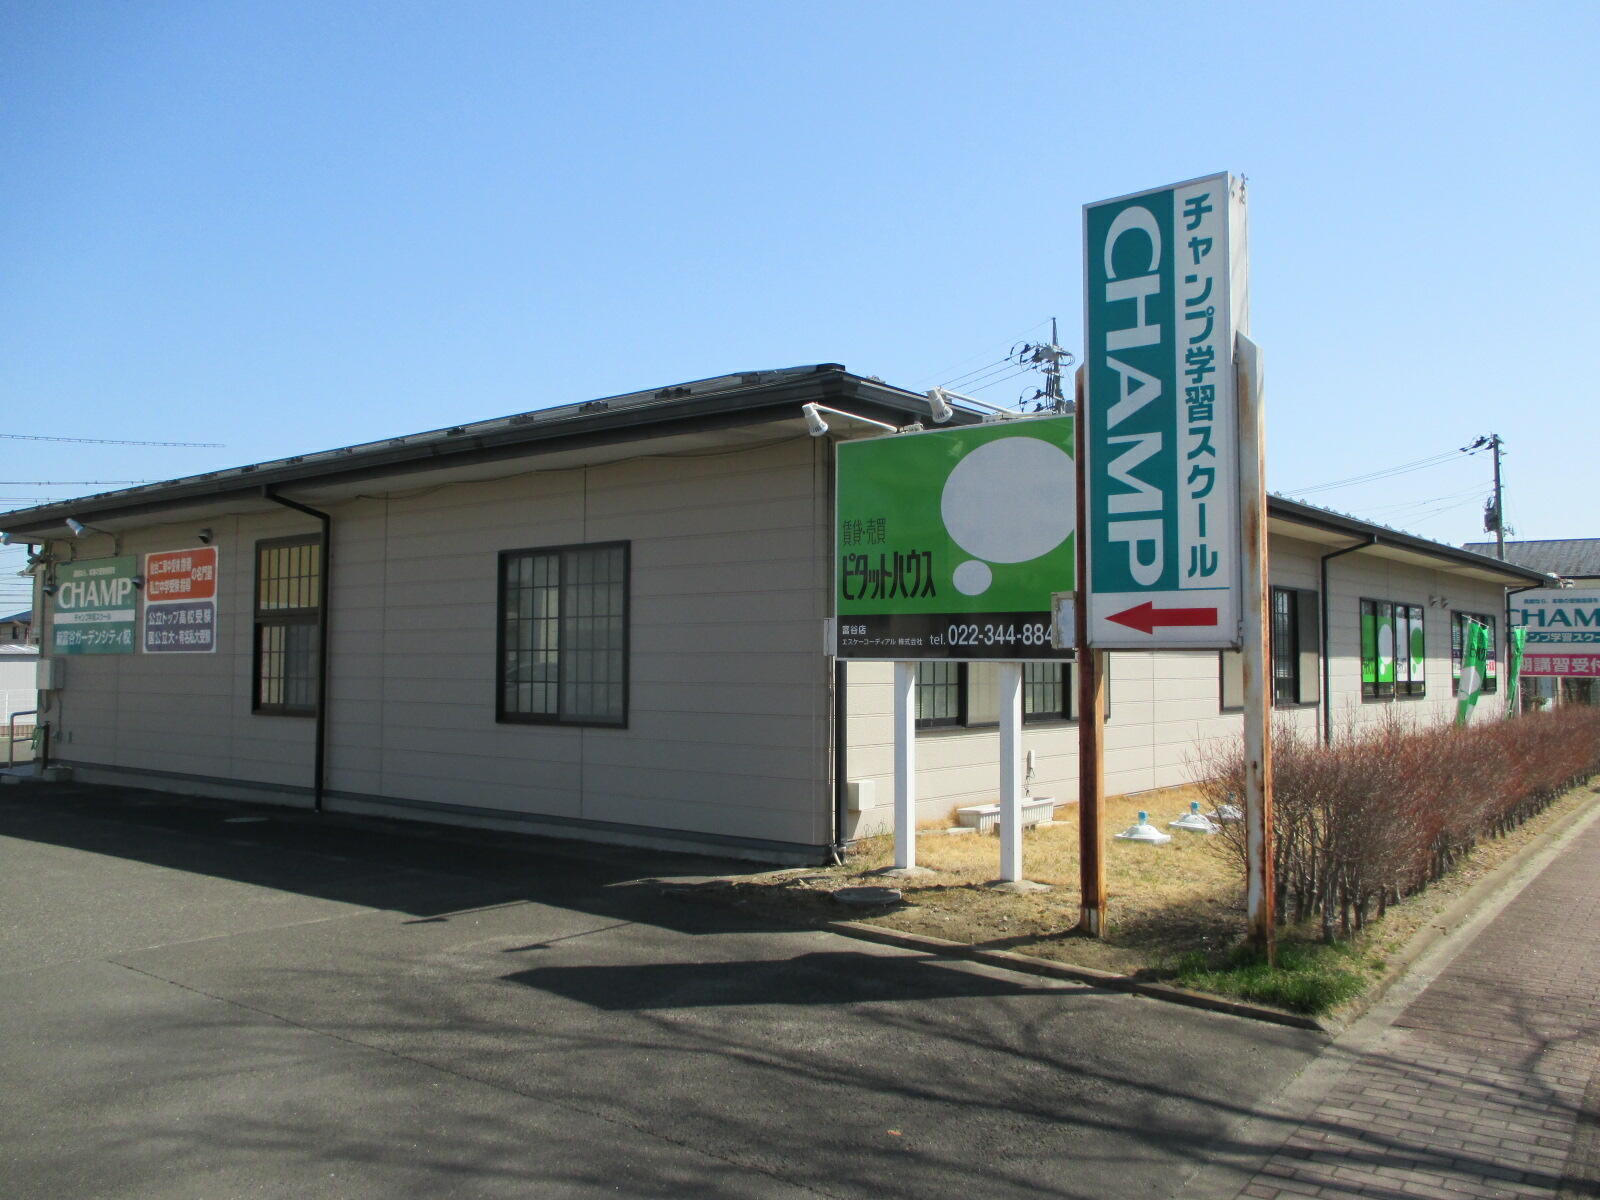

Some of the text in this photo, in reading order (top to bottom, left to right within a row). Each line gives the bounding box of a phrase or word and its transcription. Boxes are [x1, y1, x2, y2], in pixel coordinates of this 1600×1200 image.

[1103, 205, 1165, 586] CHAMP
[1182, 193, 1219, 579] チャンプ学習スクール
[842, 549, 936, 600] ピタットハウス
[58, 577, 132, 609] CHAMP
[148, 609, 211, 625] 公立トップ高校受験
[842, 625, 867, 635] 富谷店
[897, 638, 923, 646] 株式会社
